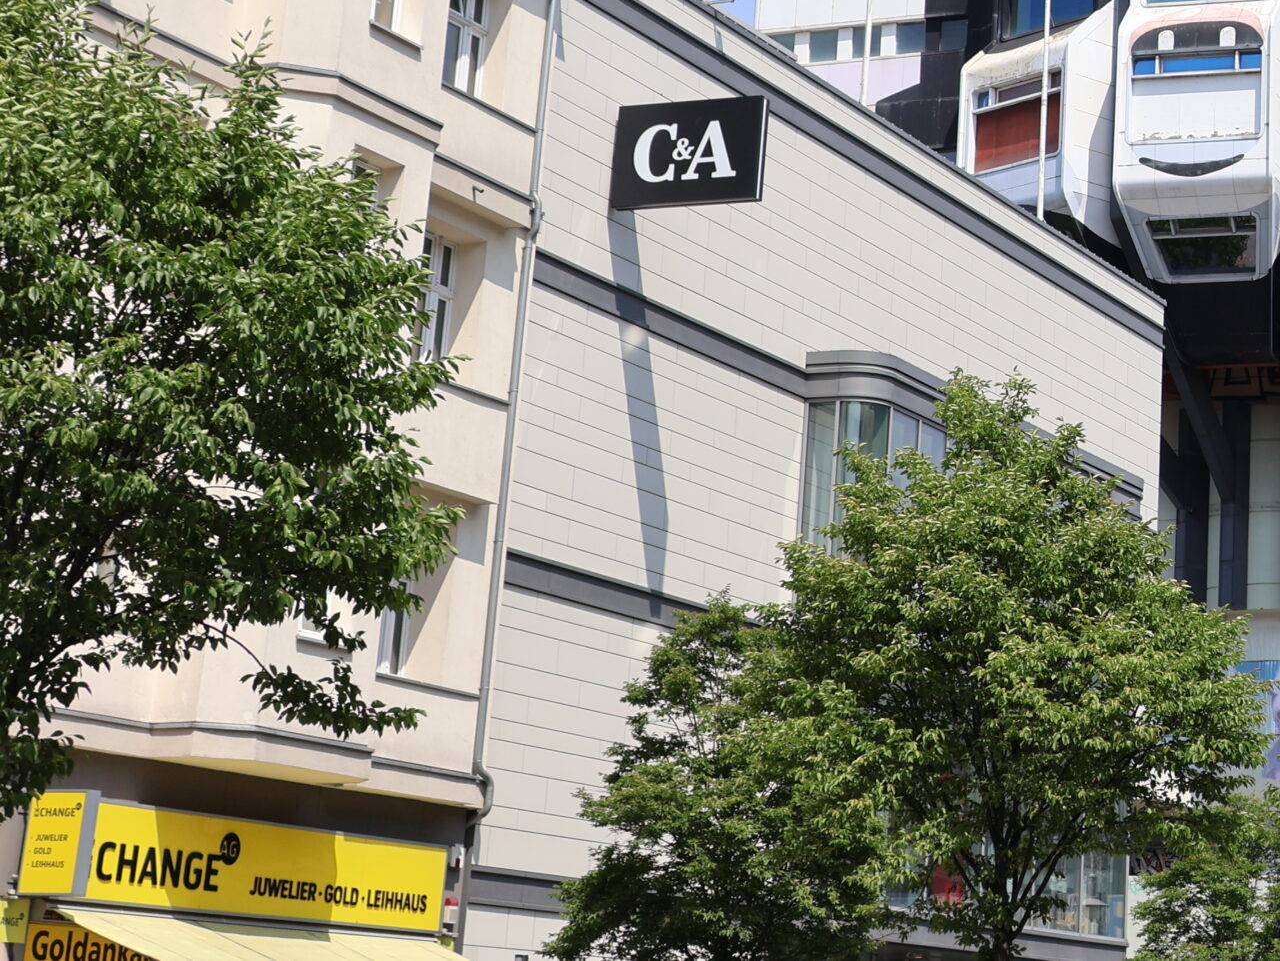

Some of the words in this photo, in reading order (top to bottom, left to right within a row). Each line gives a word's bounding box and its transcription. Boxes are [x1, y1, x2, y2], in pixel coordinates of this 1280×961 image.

[633, 120, 736, 183] C&A
[96, 841, 222, 892] CHANGE
[249, 876, 317, 901] JUWELIER
[324, 884, 359, 906] GOLD
[366, 889, 428, 913] LEIHHAUS
